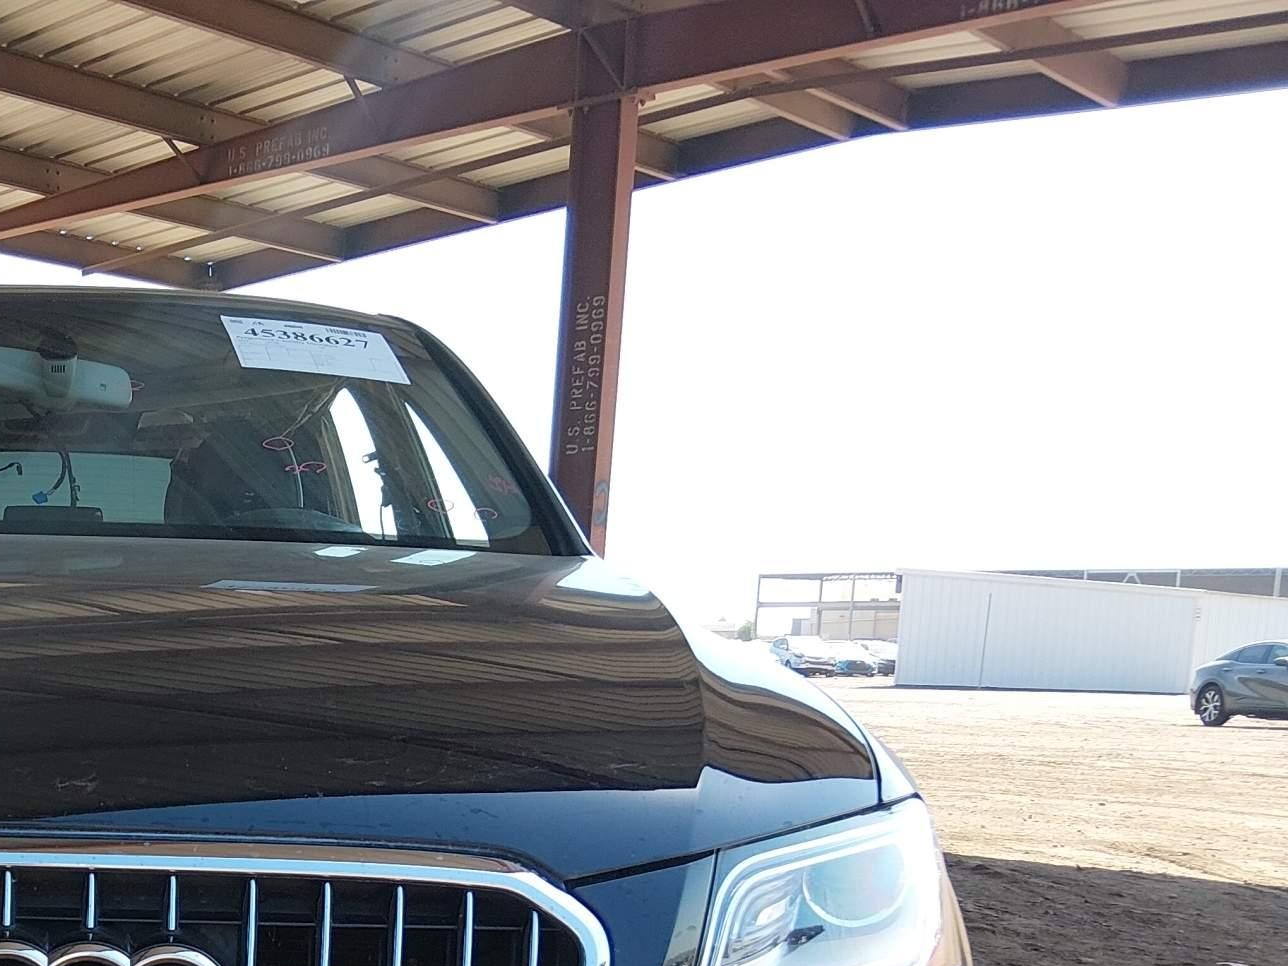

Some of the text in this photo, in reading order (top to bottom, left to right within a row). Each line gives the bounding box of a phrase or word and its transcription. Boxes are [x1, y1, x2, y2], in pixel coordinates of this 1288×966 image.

[256, 131, 302, 157] PREFAB
[575, 295, 591, 331] INC.
[244, 327, 369, 349] 45386627
[569, 339, 587, 411] PREFAB
[581, 295, 606, 453] 1-866-799-0969
